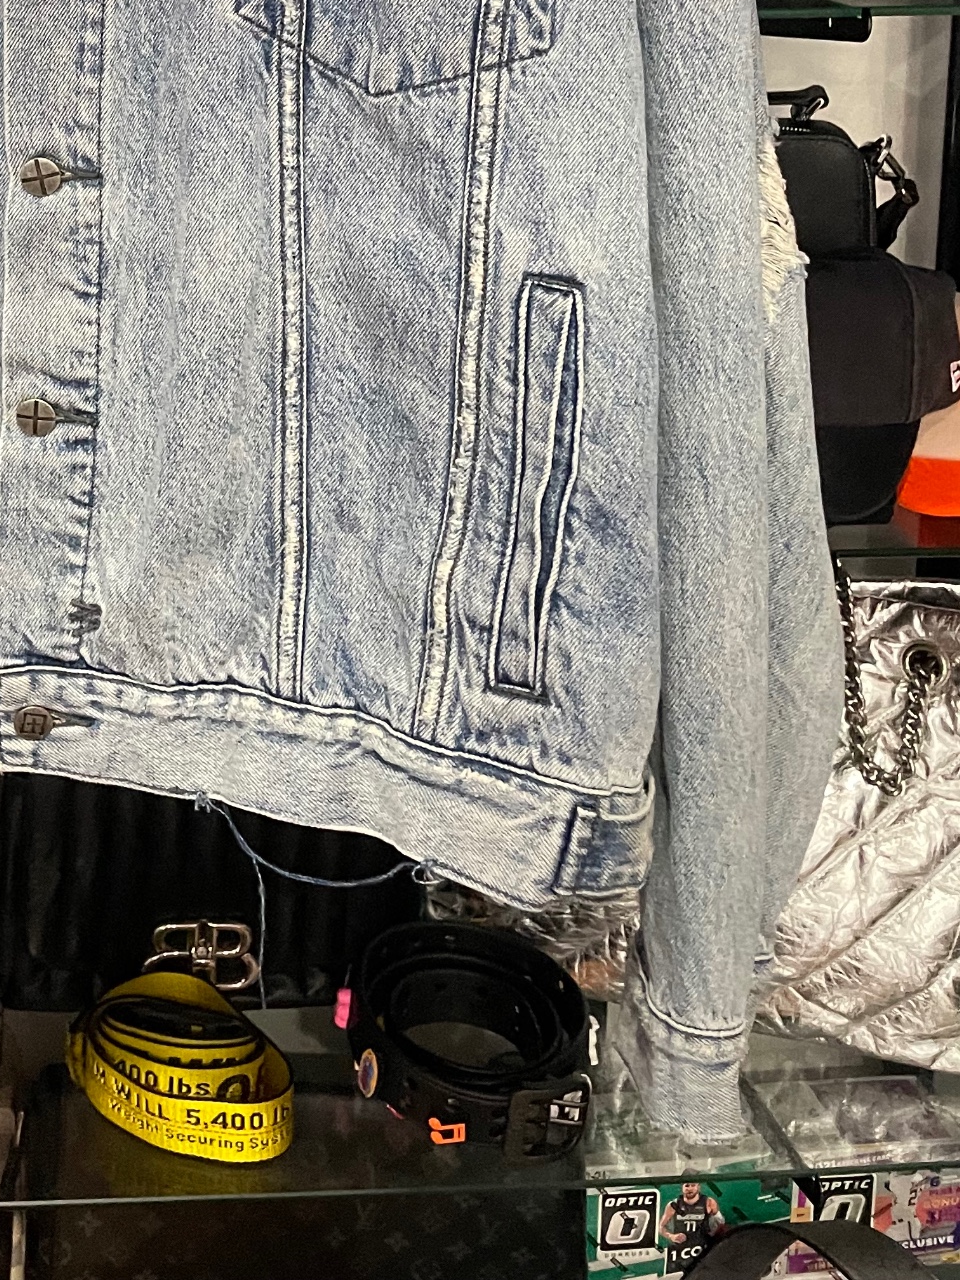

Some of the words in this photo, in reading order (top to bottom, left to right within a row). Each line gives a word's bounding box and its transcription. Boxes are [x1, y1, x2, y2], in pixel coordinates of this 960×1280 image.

[167, 1075, 211, 1097] lbs
[185, 1108, 264, 1131] 5,400
[164, 1128, 245, 1152] Securing
[604, 1195, 655, 1208] OPTIC
